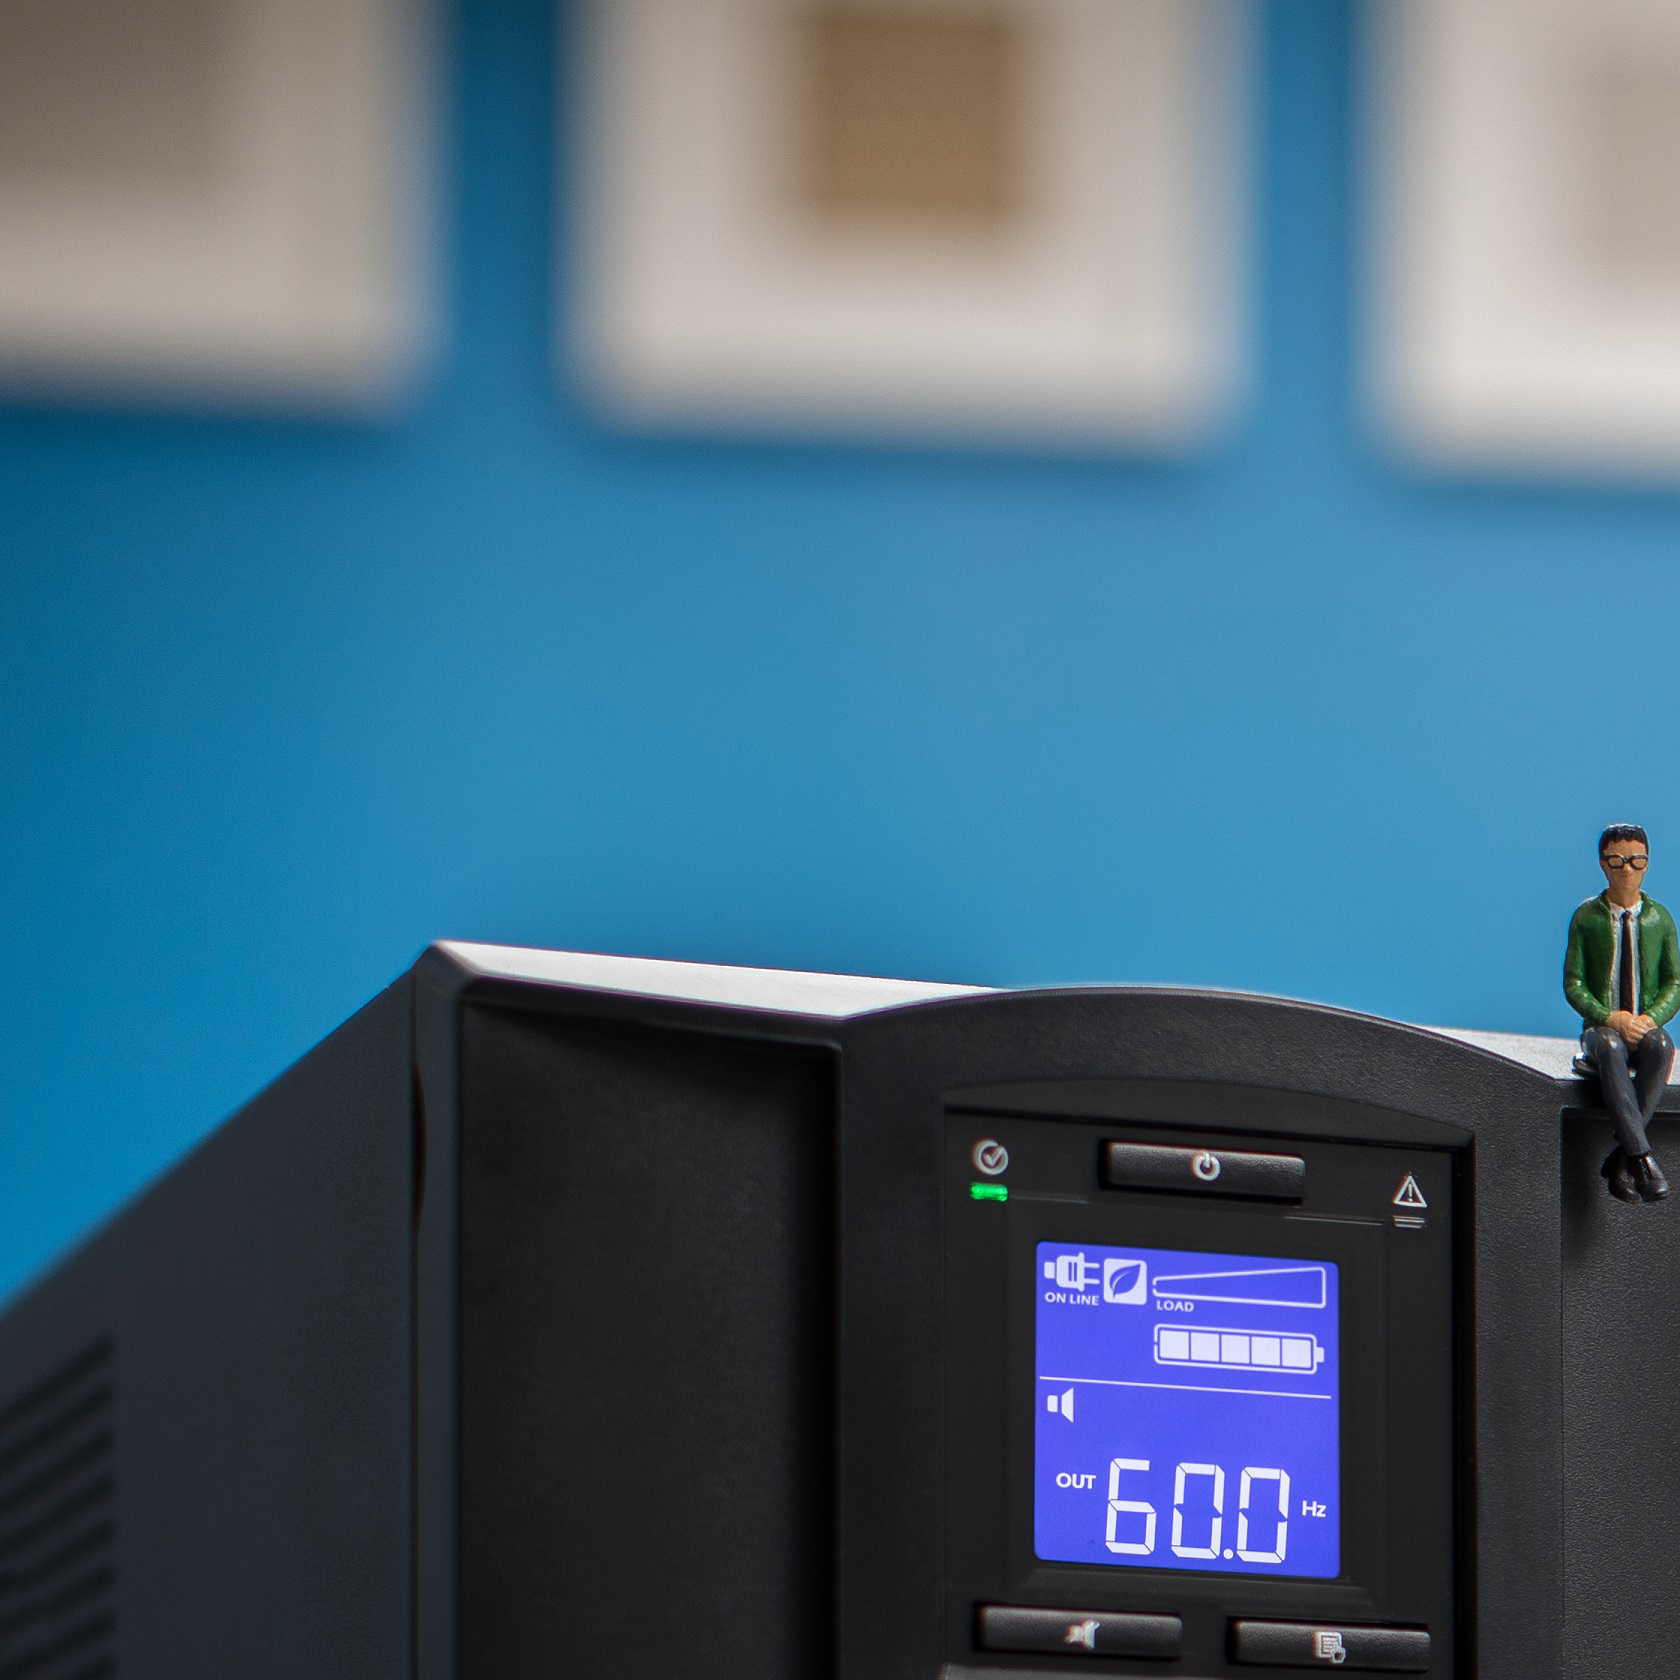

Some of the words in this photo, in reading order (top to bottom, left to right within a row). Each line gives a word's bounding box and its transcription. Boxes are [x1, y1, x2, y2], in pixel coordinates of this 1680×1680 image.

[1044, 1291, 1067, 1304] ON
[1069, 1293, 1099, 1306] LINE
[1156, 1300, 1195, 1313] LOAD
[1055, 1472, 1097, 1490] OUT
[1105, 1457, 1291, 1564] 60.0
[1301, 1500, 1328, 1518] Hz
